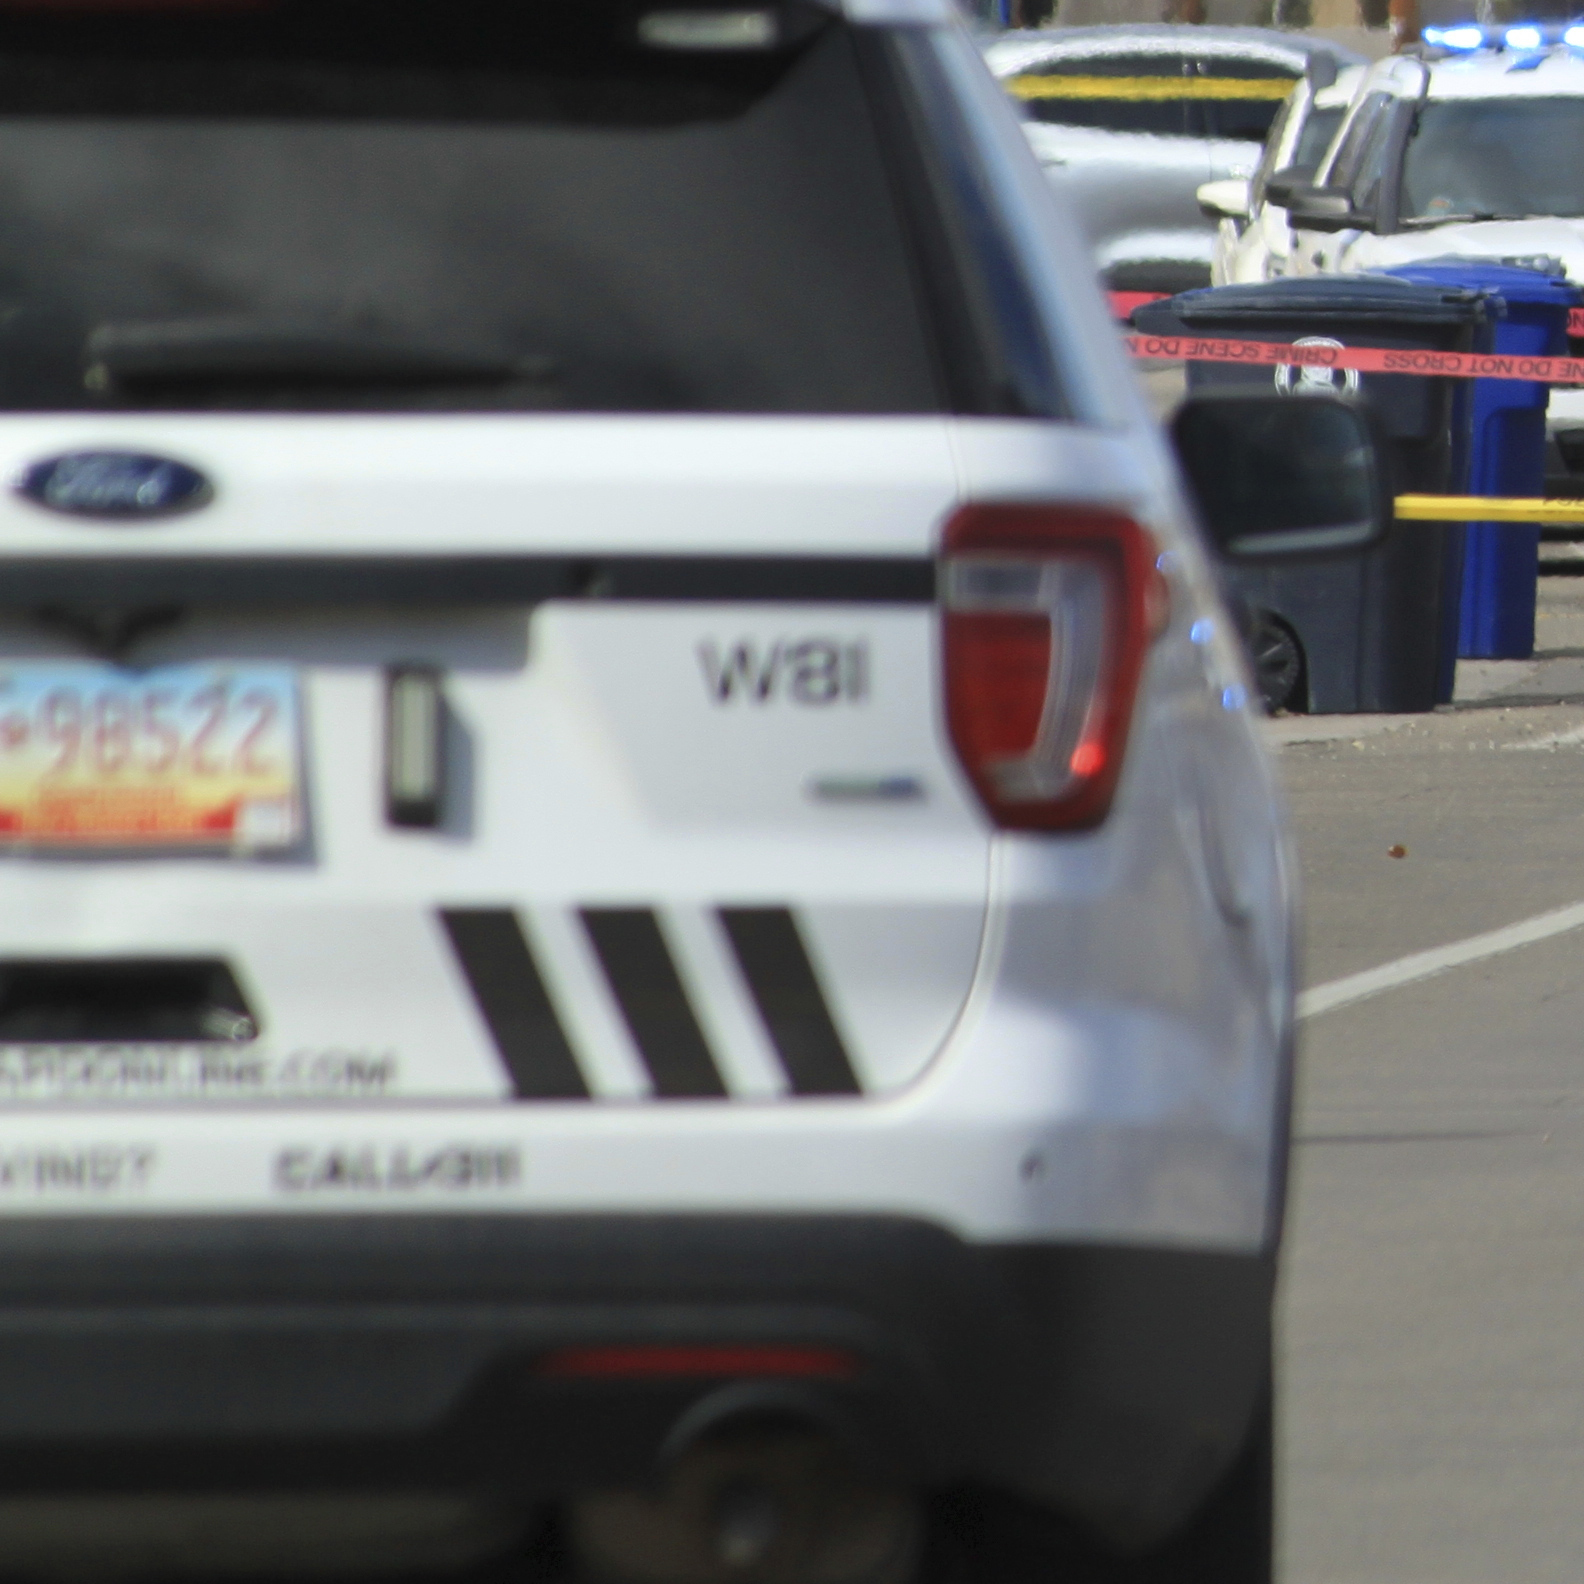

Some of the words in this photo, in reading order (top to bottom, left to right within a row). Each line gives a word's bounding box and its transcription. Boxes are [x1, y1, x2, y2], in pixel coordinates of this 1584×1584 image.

[1145, 339, 1178, 356] DO
[1186, 341, 1261, 362] SCENE
[1267, 344, 1338, 365] CRIME
[1384, 352, 1461, 373] CROSS
[1467, 355, 1513, 377] NOT
[1519, 358, 1551, 378] DO
